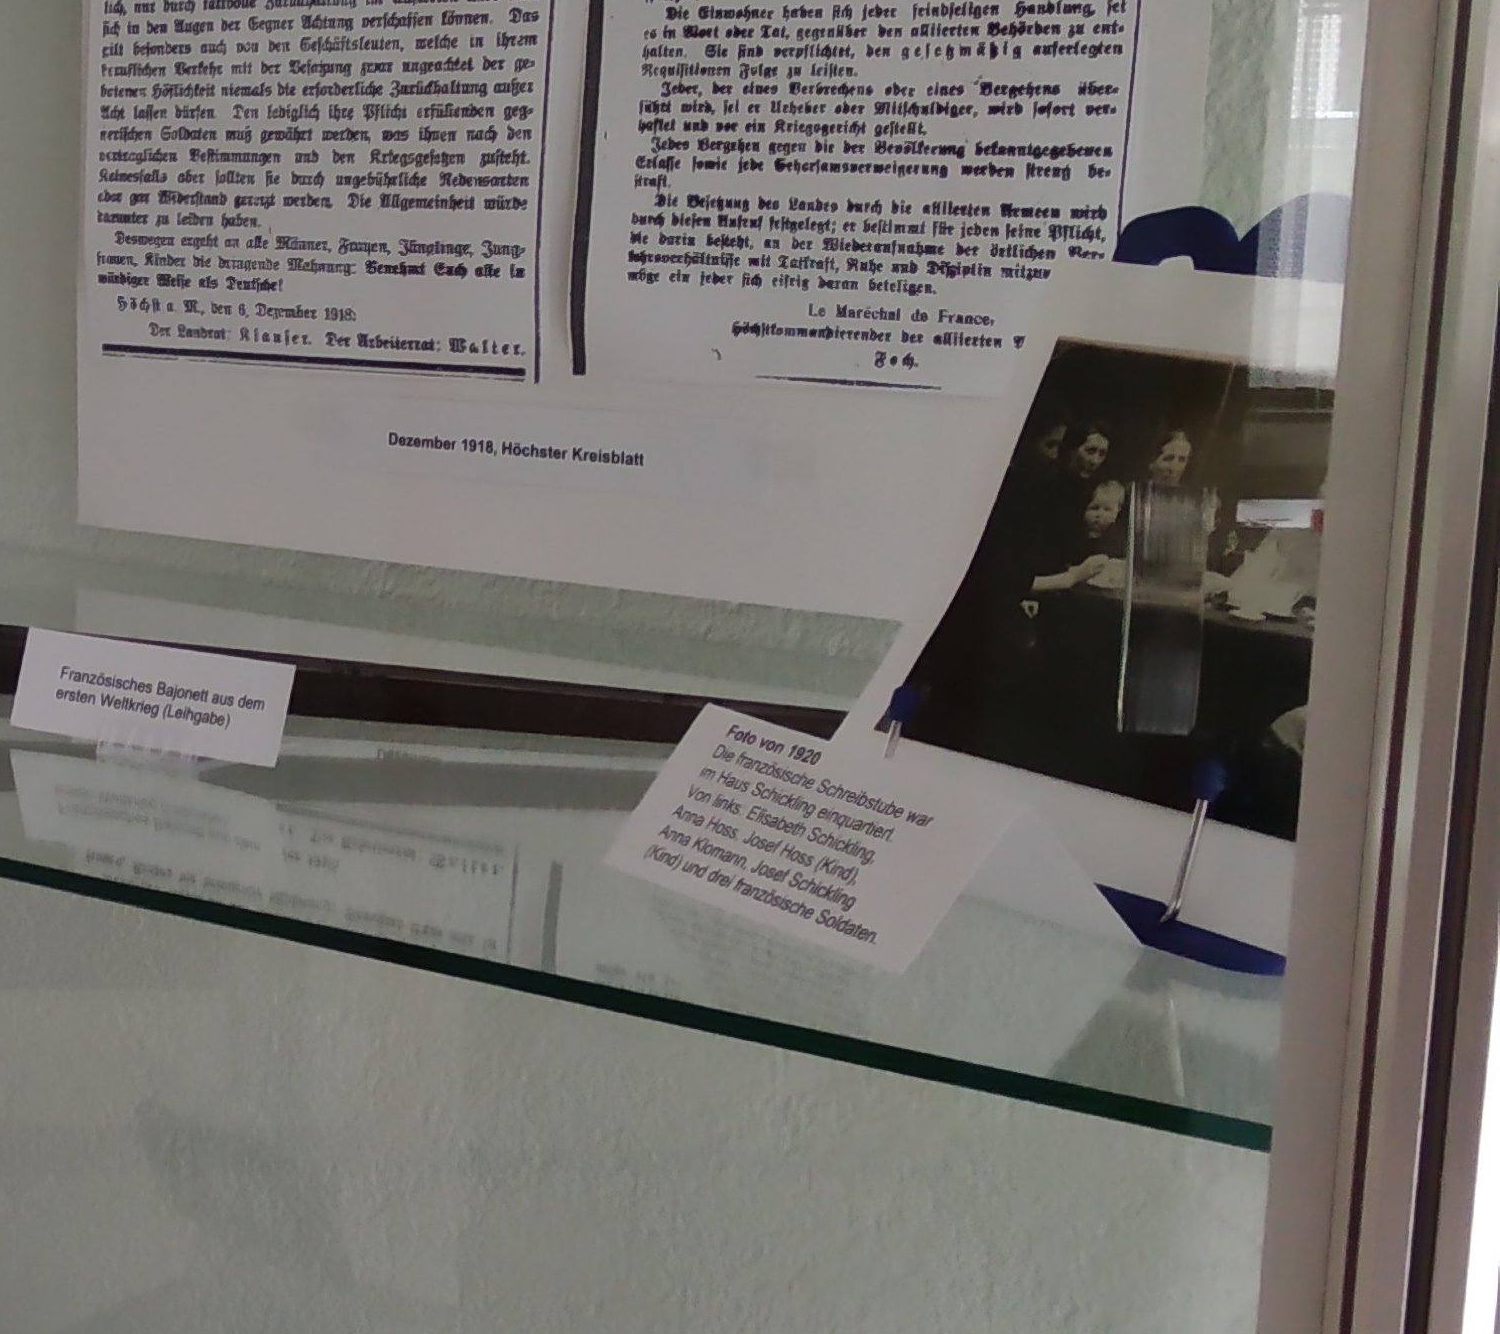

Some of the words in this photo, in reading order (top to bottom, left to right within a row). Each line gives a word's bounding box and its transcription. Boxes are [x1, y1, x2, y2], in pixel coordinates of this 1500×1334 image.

[808, 302, 826, 317] Le
[835, 303, 901, 321] Maréchal
[910, 308, 929, 322] de
[388, 432, 457, 451] Dezember
[461, 439, 498, 456] 1918,
[502, 441, 568, 460] Höchster
[572, 447, 645, 467] Kreisblatt
[55, 688, 96, 705] ersten
[100, 692, 160, 719] Weltkrieg
[161, 703, 231, 729] (Leihgabe)
[59, 665, 153, 694] Französisches
[155, 680, 209, 703] Bajonett
[210, 693, 235, 707] aus
[237, 694, 265, 711] dem
[725, 723, 757, 745] Foto
[758, 737, 785, 755] von
[787, 744, 822, 766] 1920
[687, 783, 712, 804] Von
[699, 766, 717, 781] im
[716, 769, 751, 793] Haus
[750, 780, 817, 819] Schickling
[711, 743, 736, 763] Die
[735, 750, 816, 790] französische
[815, 778, 905, 819] Schreibstube
[905, 810, 935, 827] war
[671, 804, 705, 827] Anna
[741, 830, 784, 854] Josef
[779, 842, 815, 867] Hoss
[643, 844, 684, 871] (Kind)
[680, 860, 710, 878] und
[706, 868, 737, 888] drei
[732, 877, 815, 920] französische
[657, 824, 692, 847] Anna
[749, 859, 792, 883] Josef
[787, 871, 857, 912] Schickling
